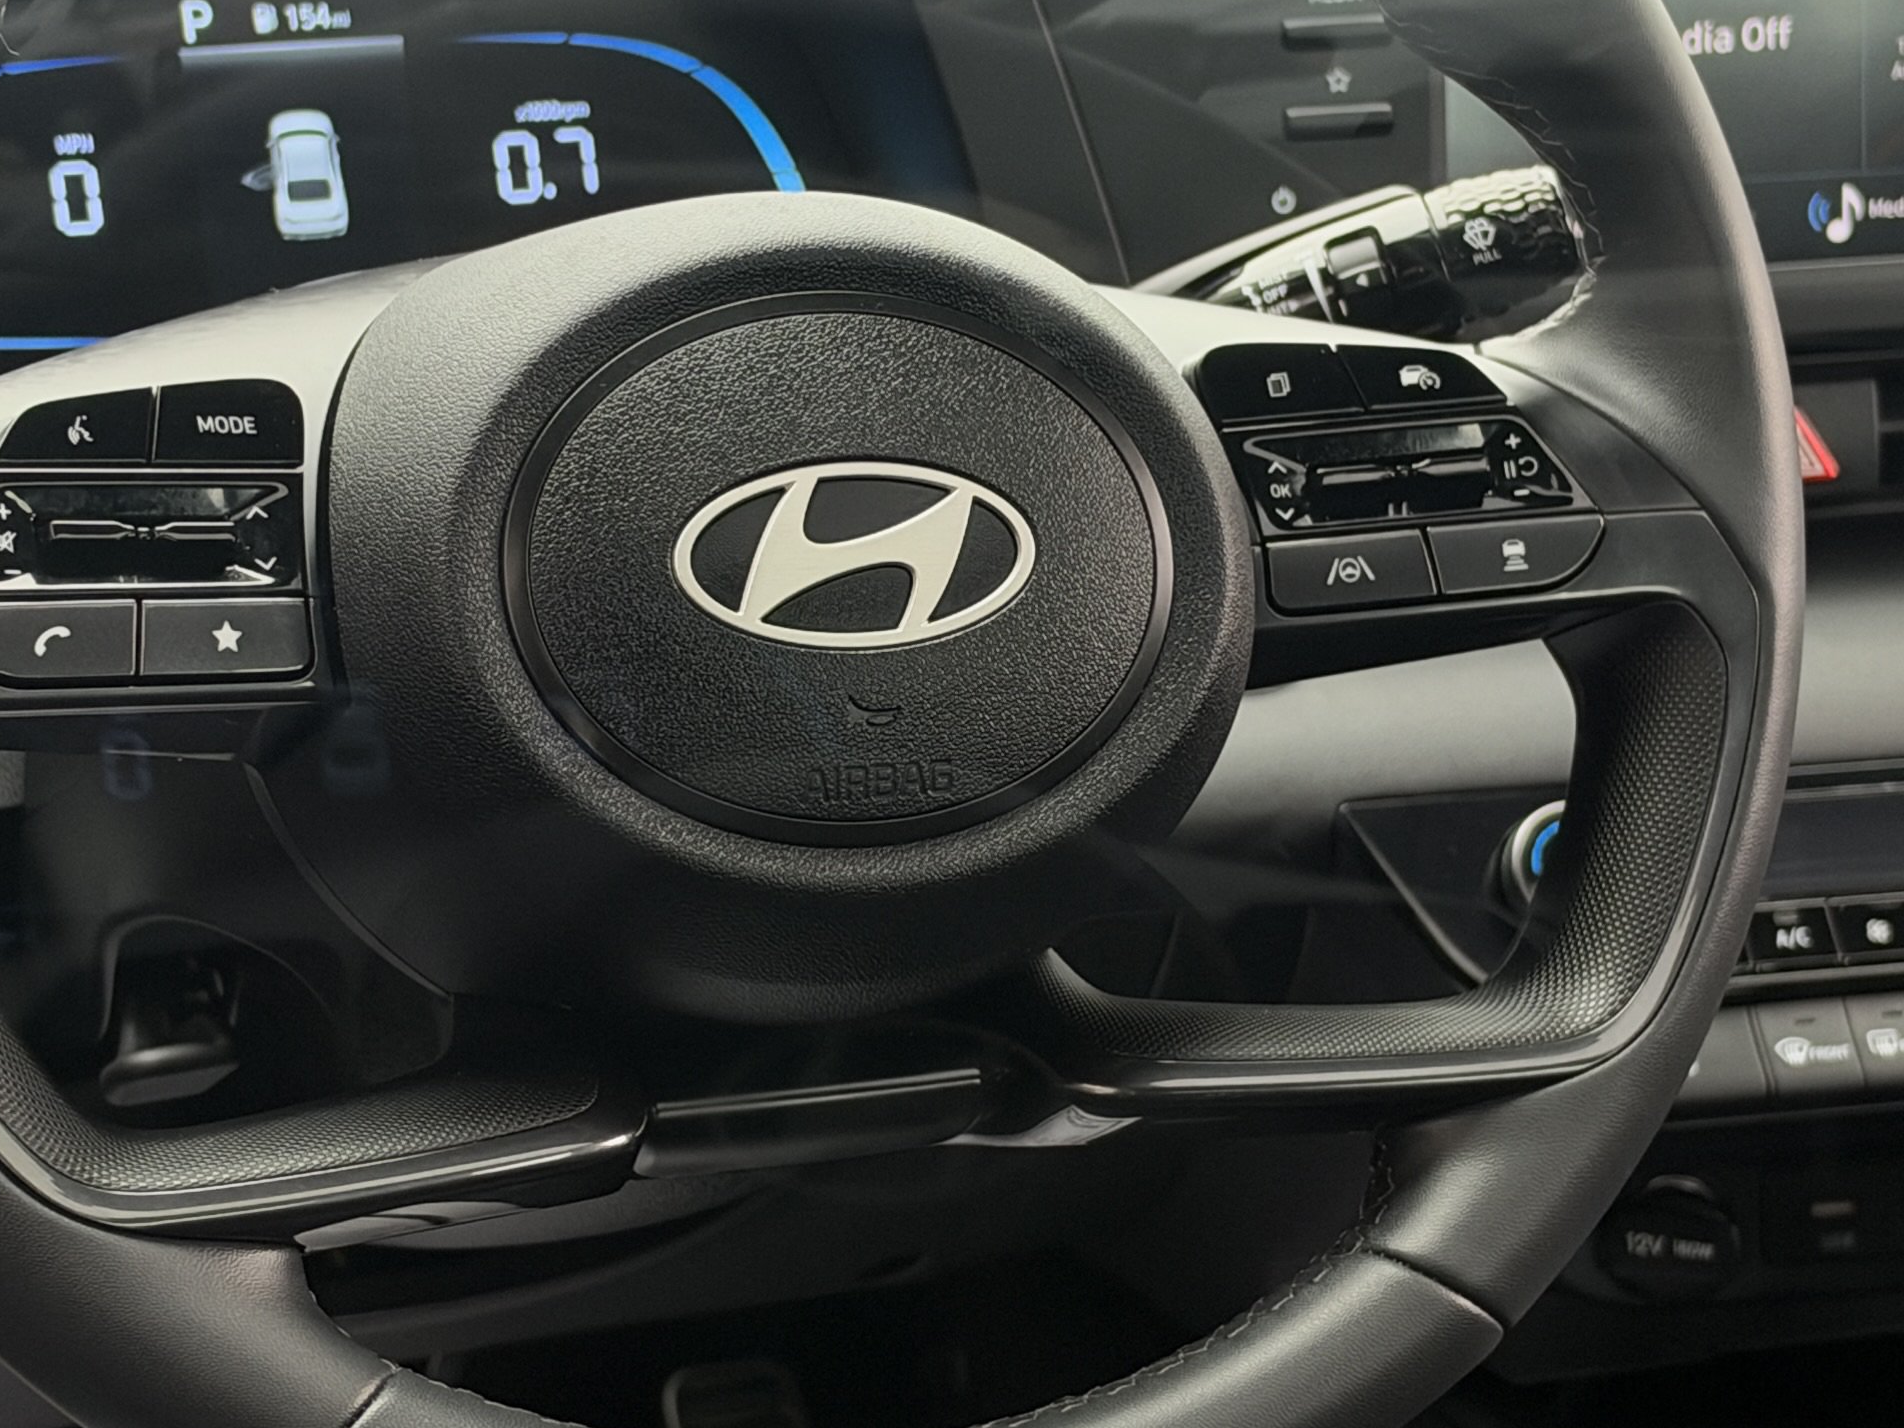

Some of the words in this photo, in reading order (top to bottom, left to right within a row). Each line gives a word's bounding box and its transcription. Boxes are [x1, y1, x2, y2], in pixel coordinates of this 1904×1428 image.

[1741, 15, 1794, 52] Off
[492, 125, 600, 207] 0.7
[47, 159, 105, 238] 0
[196, 415, 258, 436] MODE
[1269, 483, 1292, 500] OK
